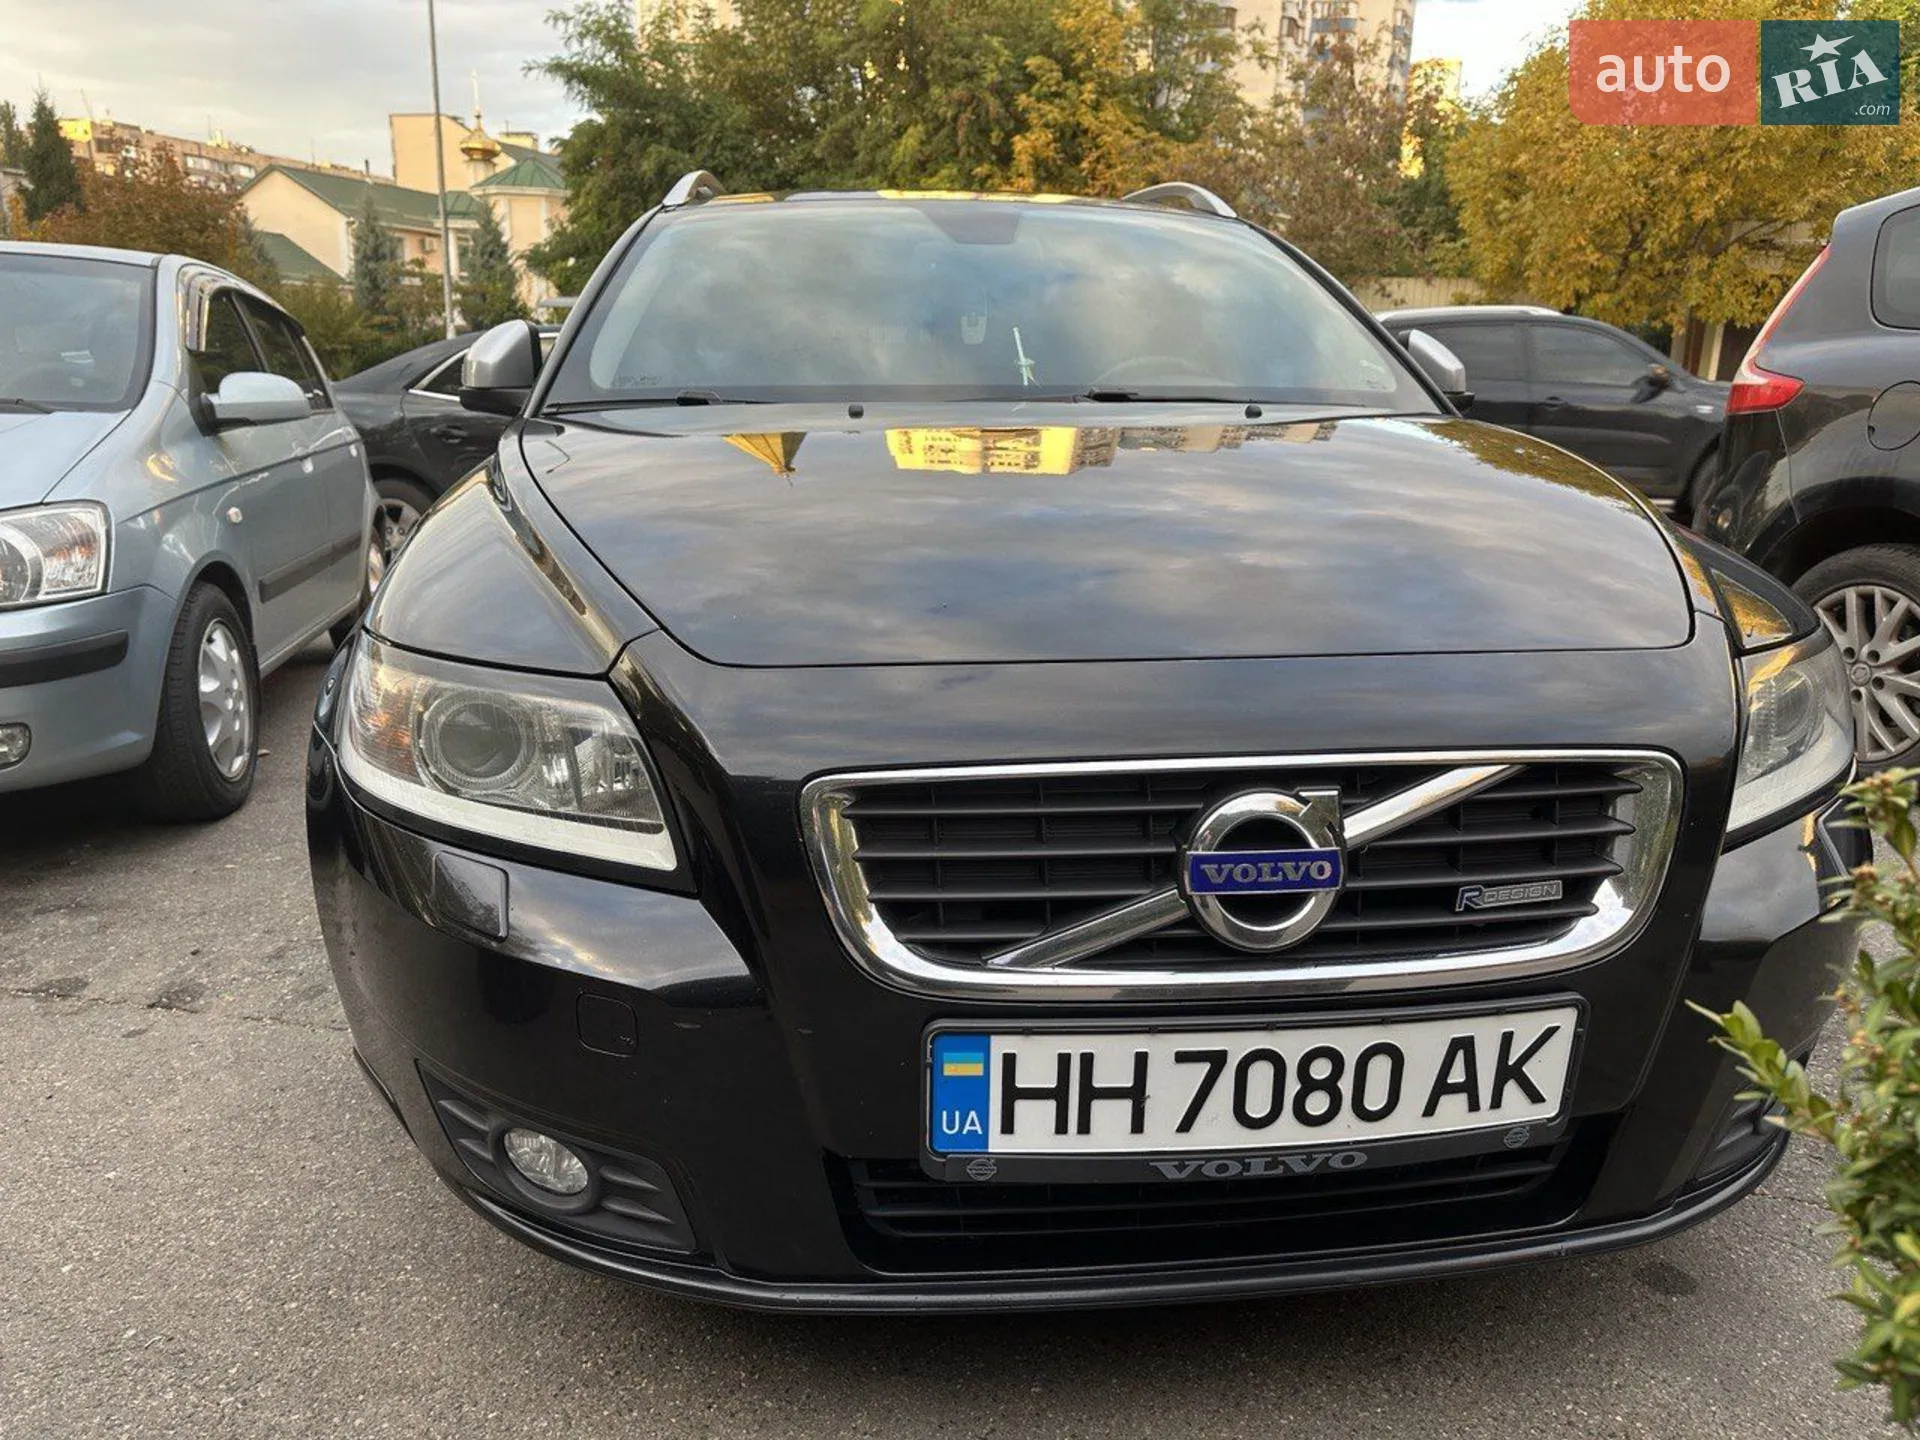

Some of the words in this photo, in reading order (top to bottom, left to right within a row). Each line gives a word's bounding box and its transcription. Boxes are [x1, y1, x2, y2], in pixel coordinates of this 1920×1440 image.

[1200, 860, 1333, 884] VOLVO
[1000, 1050, 1149, 1135] HH
[1173, 1041, 1407, 1133] 7080
[1421, 1025, 1561, 1118] AK
[942, 1110, 983, 1136] UA
[1150, 1151, 1368, 1180] VOLVO
